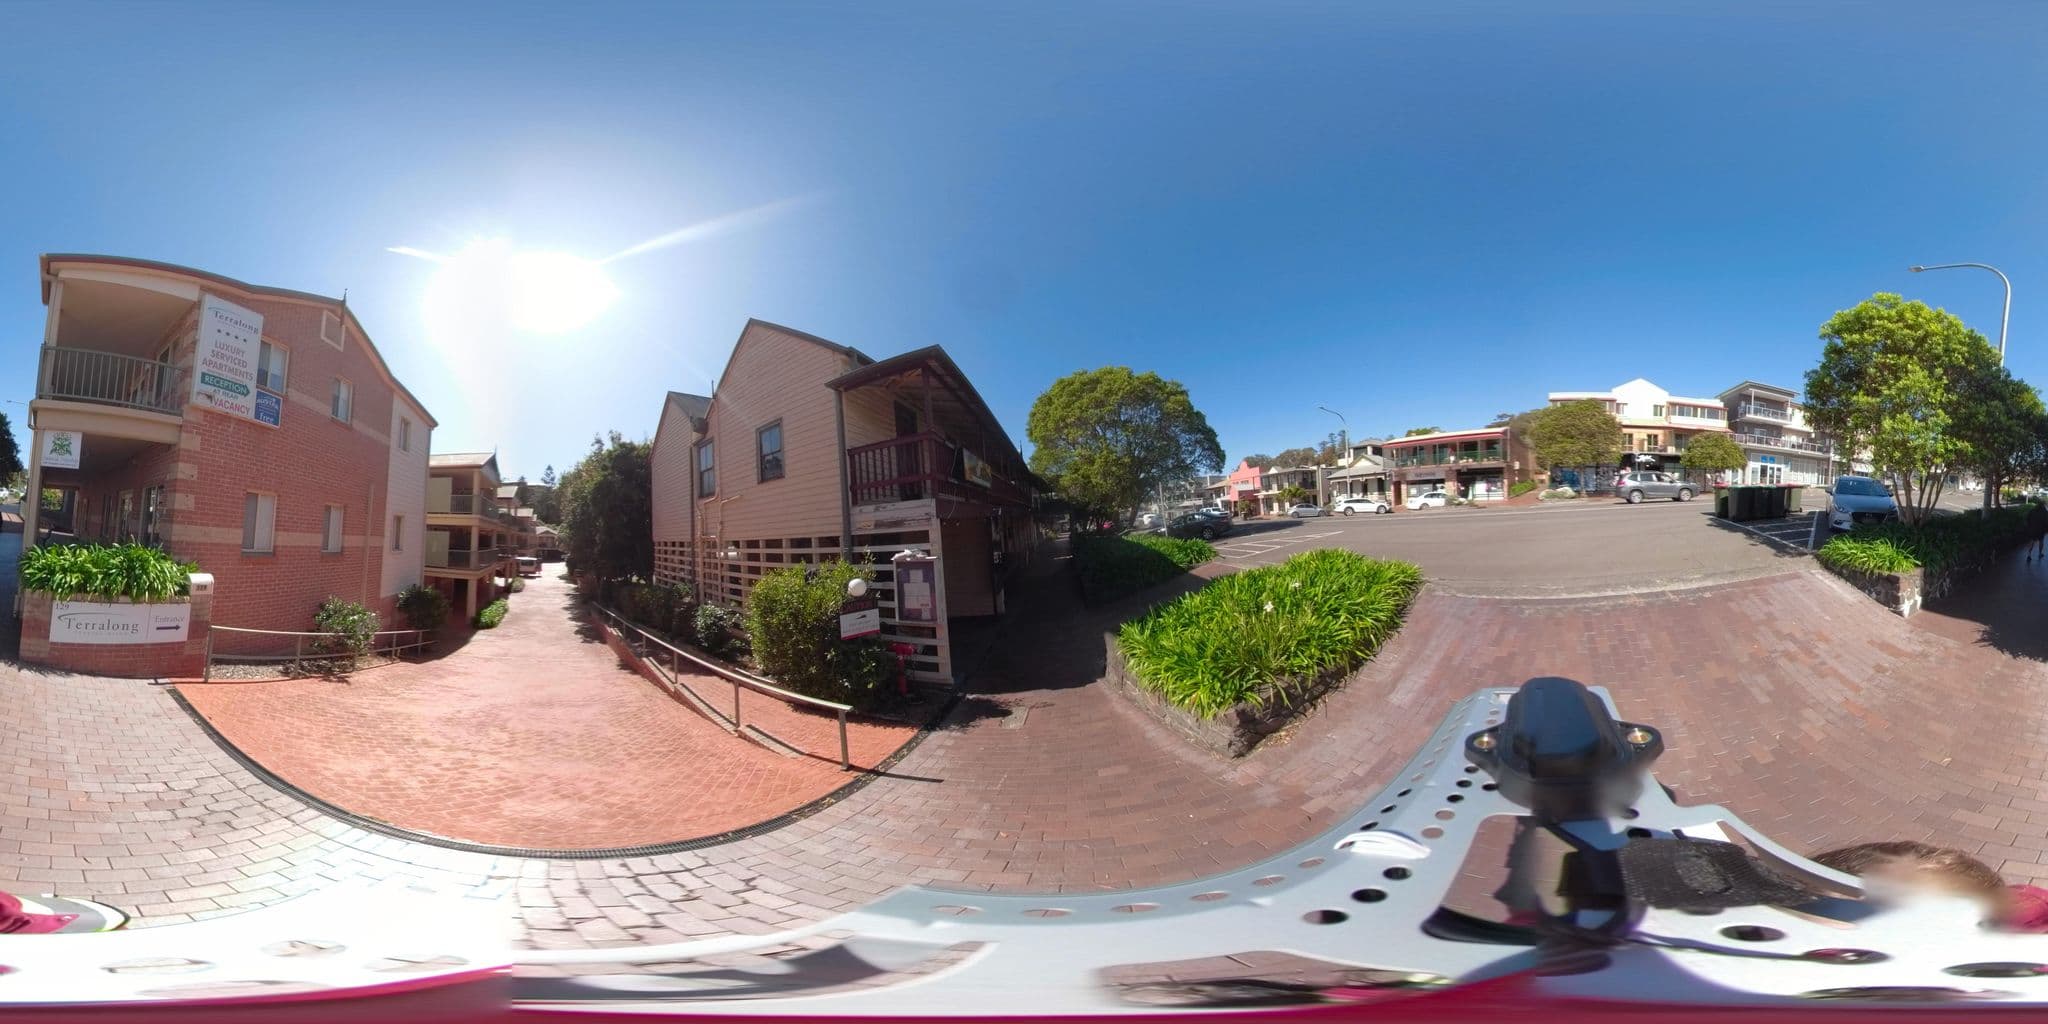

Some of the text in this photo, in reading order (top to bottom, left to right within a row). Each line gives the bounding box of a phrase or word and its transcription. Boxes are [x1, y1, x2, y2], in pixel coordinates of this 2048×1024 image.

[214, 341, 246, 358] LUXURY
[210, 350, 248, 369] SERVICED
[201, 358, 254, 381] APARTMENTS
[204, 375, 248, 396] RECEPTION
[213, 396, 251, 415] VACANCY
[64, 617, 140, 634] Terralong
